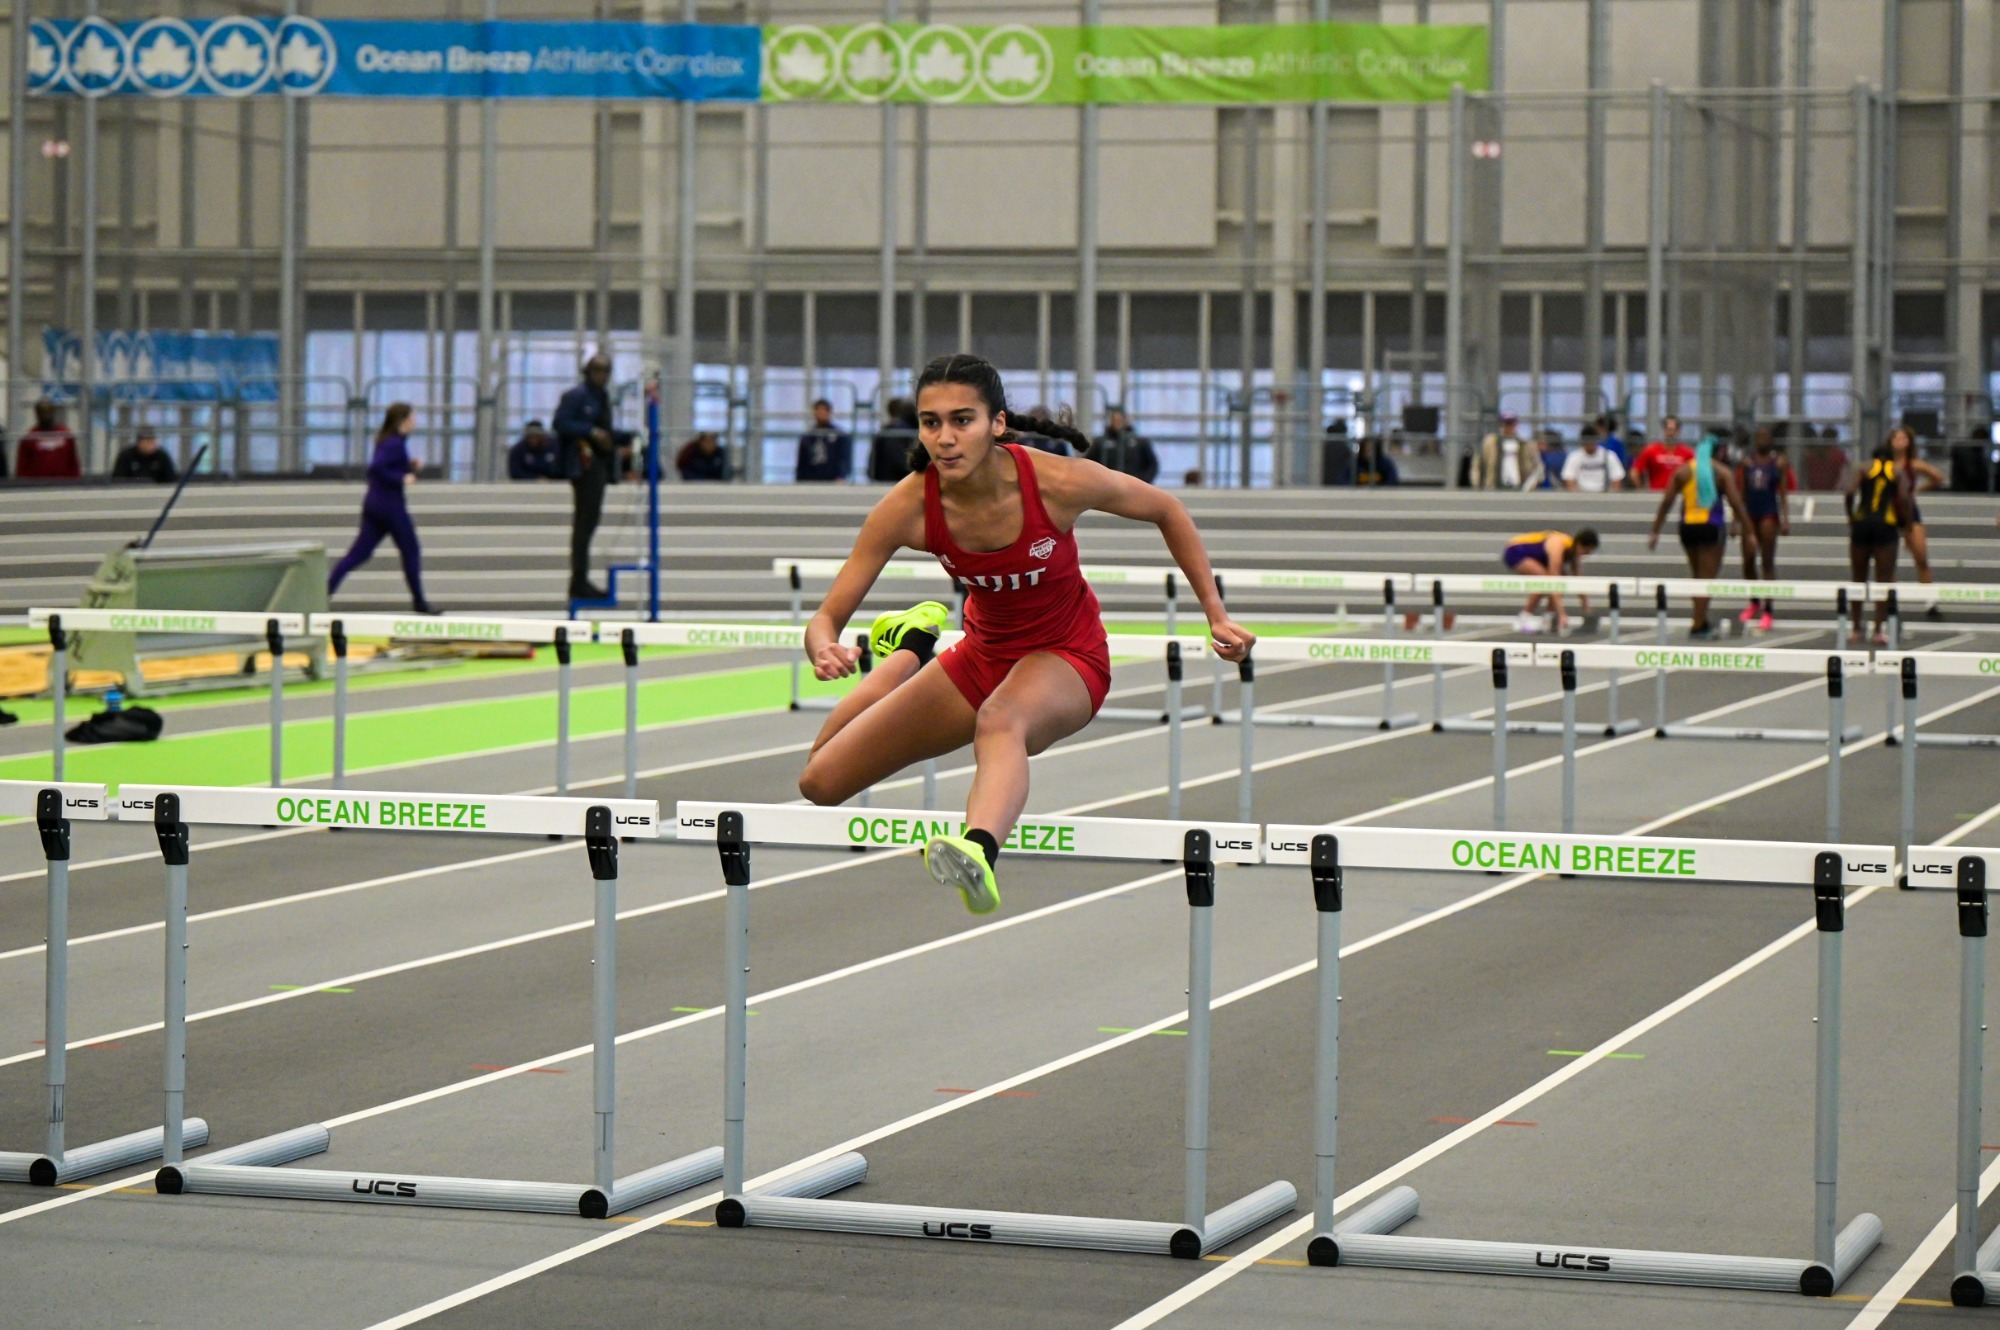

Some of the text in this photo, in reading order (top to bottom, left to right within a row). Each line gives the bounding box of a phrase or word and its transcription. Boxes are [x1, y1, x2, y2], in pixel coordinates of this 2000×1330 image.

[355, 44, 744, 78] Ocean Breeze Athletic Complex
[1074, 52, 1157, 77] Ocean
[1160, 52, 1255, 77] Breeze
[110, 614, 217, 631] OCEAN BREEZE
[393, 620, 503, 637] OCEAN BREEZE
[687, 628, 802, 647] OCEAN BREEZE
[1308, 642, 1434, 661] OCEAN BREEZE
[1635, 650, 1766, 670] OCEAN BREEZE
[66, 798, 99, 808] UCS
[122, 800, 154, 810] UCS
[276, 797, 487, 829] OCEAN BREEZE
[615, 815, 651, 826] UCS
[681, 817, 716, 828] UCS
[1215, 840, 1253, 850] UCS
[1271, 842, 1308, 852] UCS
[1451, 839, 1697, 875] OCEAN BREEZE
[1847, 863, 1887, 874] UCS
[1912, 864, 1953, 875] UCS
[352, 1178, 417, 1198] UCS
[922, 1221, 993, 1240] UCS
[1536, 1251, 1611, 1272] UCS
